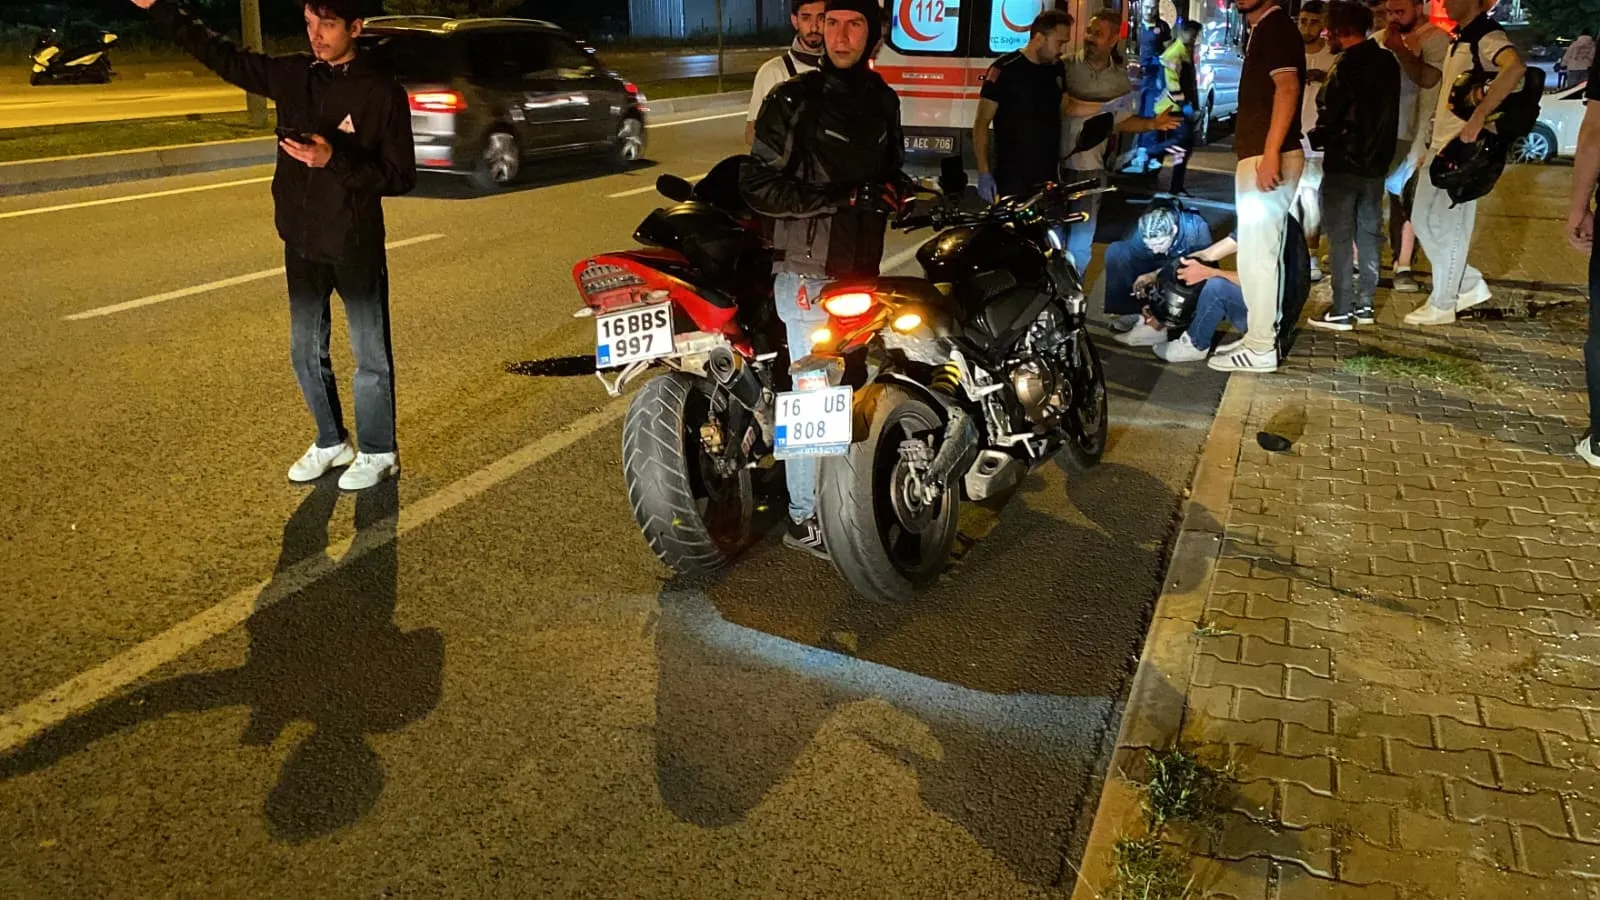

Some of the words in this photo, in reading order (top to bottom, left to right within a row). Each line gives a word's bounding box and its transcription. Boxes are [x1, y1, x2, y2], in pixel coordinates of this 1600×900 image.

[916, 0, 944, 22] 112
[913, 137, 929, 149] AEC
[935, 138, 951, 150] 706
[602, 309, 667, 338] 16BBS
[616, 334, 653, 357] 997
[783, 398, 801, 418] 16
[824, 393, 846, 413] UB
[793, 420, 826, 440] 808
